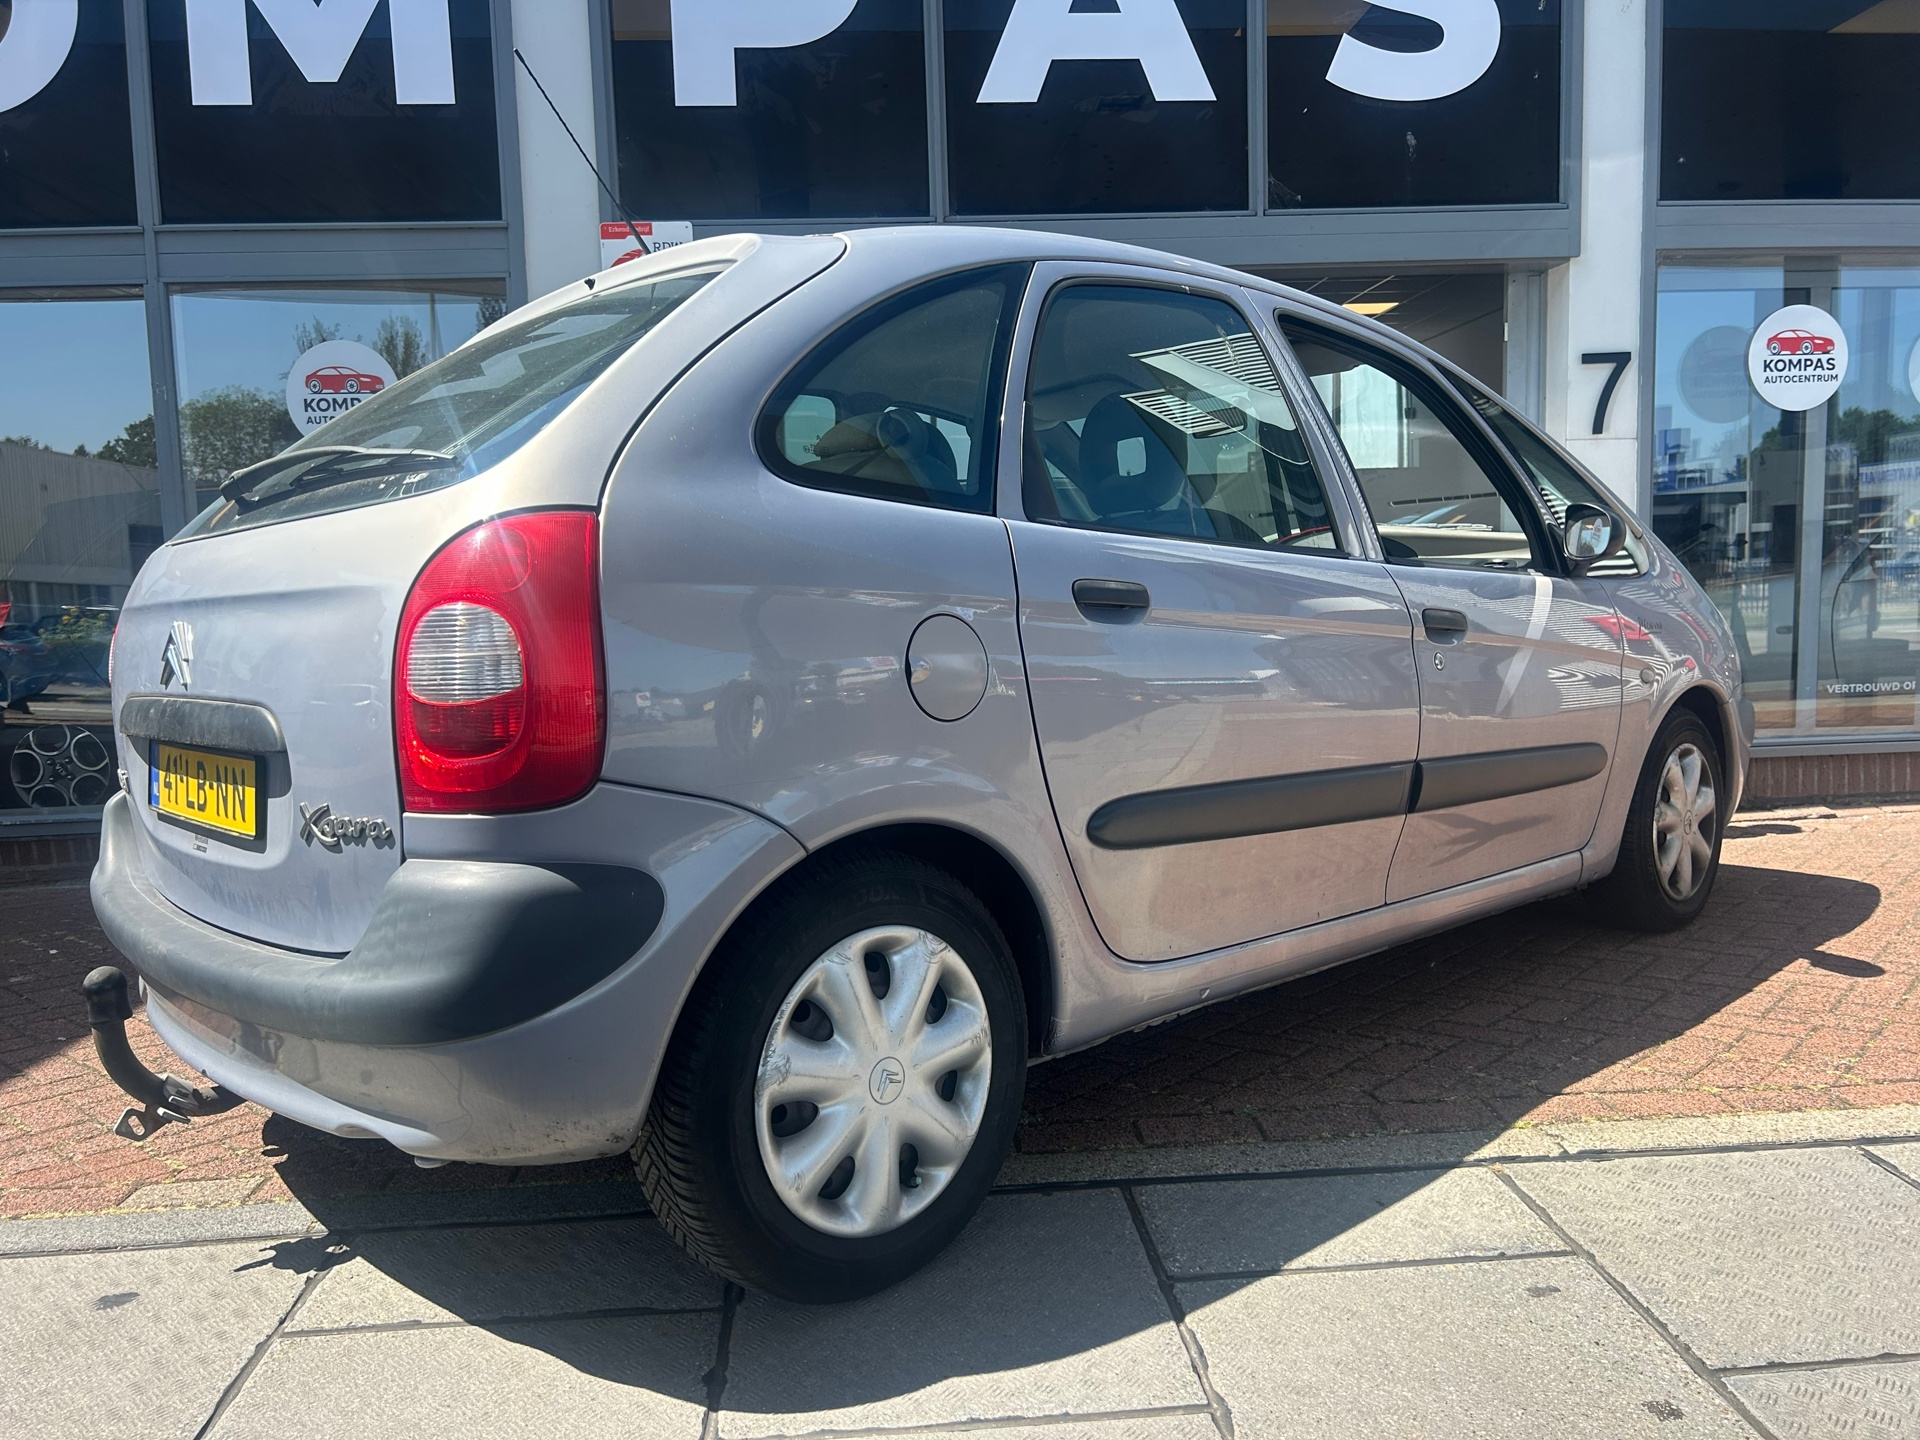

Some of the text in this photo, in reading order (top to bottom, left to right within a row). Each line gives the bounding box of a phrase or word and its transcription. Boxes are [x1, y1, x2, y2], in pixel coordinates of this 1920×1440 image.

[1763, 357, 1836, 373] KOMPAS
[1763, 373, 1839, 384] AUTOCENTRUM
[1581, 351, 1632, 435] 7
[1826, 682, 1901, 694] VERTROUWD
[300, 802, 392, 847] Xsara
